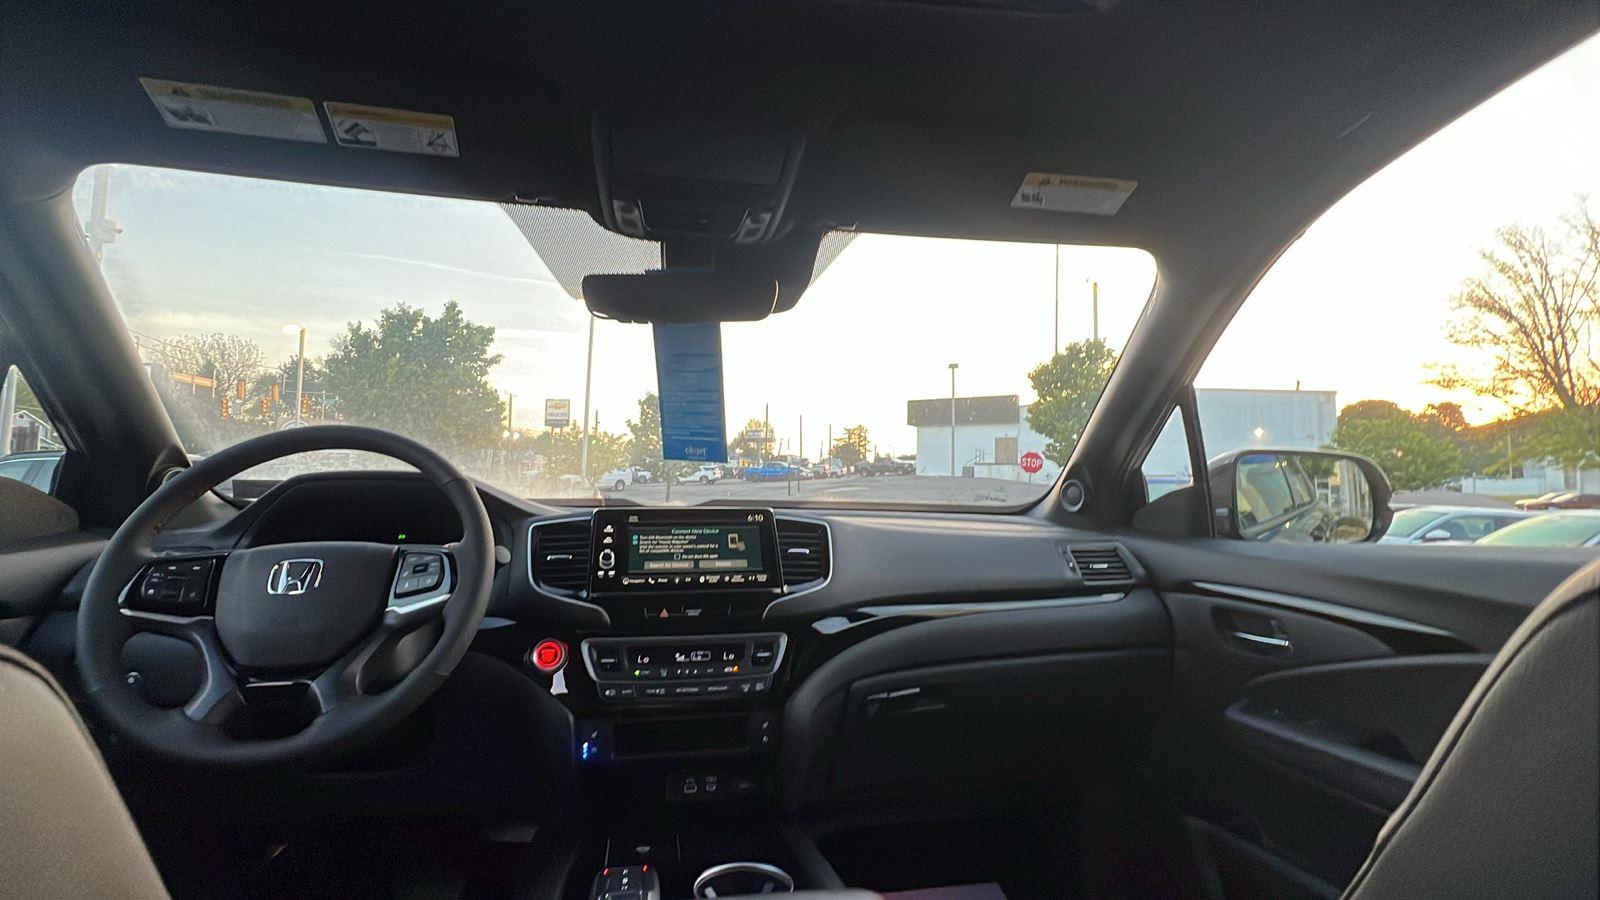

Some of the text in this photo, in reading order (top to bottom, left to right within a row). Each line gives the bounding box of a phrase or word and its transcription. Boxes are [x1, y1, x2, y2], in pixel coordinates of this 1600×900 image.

[1021, 457, 1042, 468] STOP
[747, 513, 764, 522] 6:10
[636, 655, 650, 664] Lo
[722, 651, 736, 661] Lo
